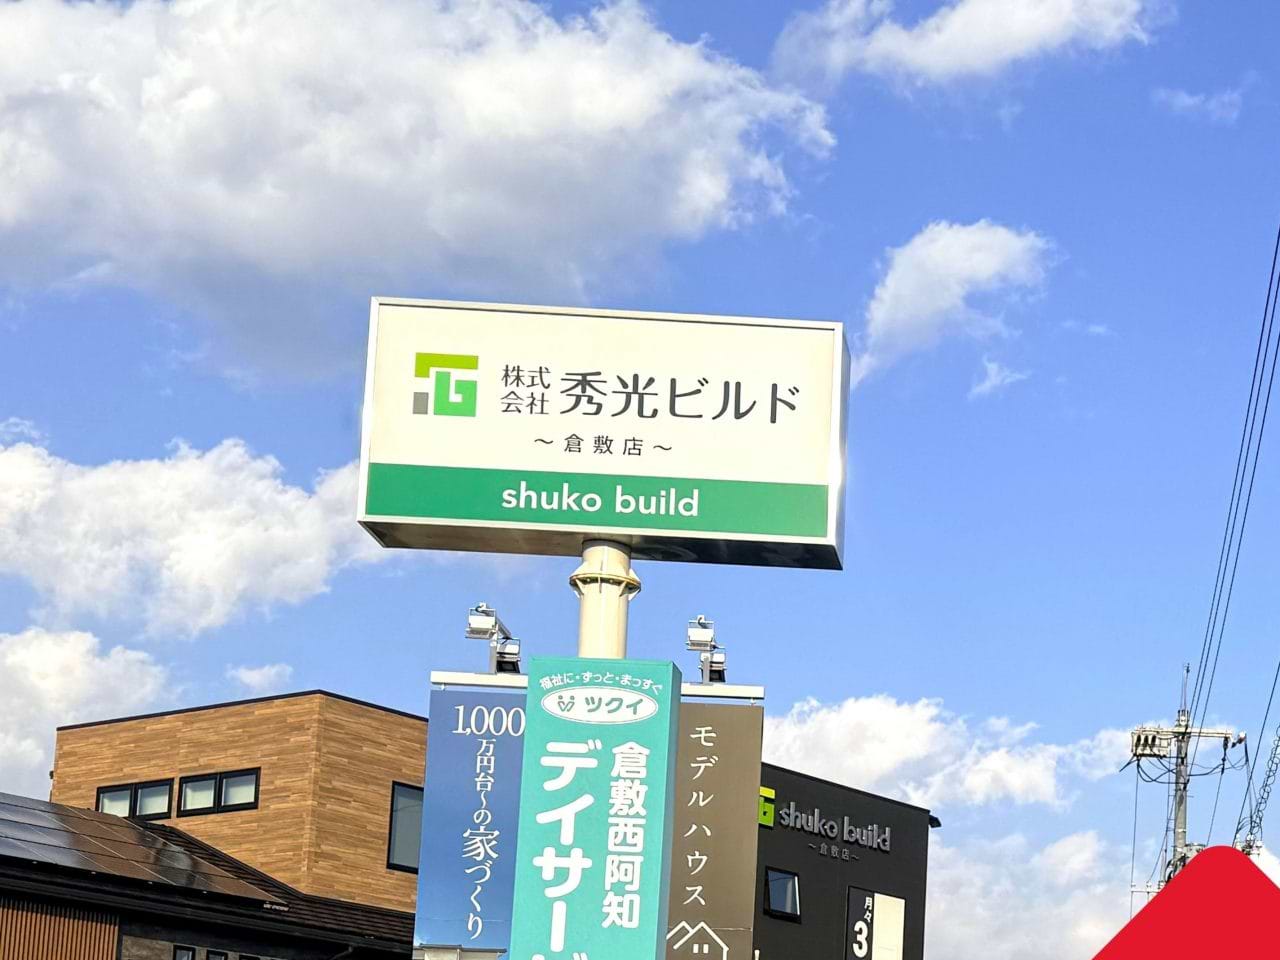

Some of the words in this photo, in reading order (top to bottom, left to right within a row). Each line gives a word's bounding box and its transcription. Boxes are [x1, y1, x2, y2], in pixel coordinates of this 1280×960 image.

[501, 364, 550, 389] 株式
[560, 371, 800, 424] 秀光ビルド
[500, 391, 549, 415] 会社
[502, 480, 602, 512] shuko
[615, 485, 699, 517] build
[585, 696, 643, 715] ツクイ
[601, 741, 650, 929] 倉敷西阿知
[682, 726, 718, 906] モデルハウス
[779, 802, 838, 838] shuko
[843, 815, 891, 851] build
